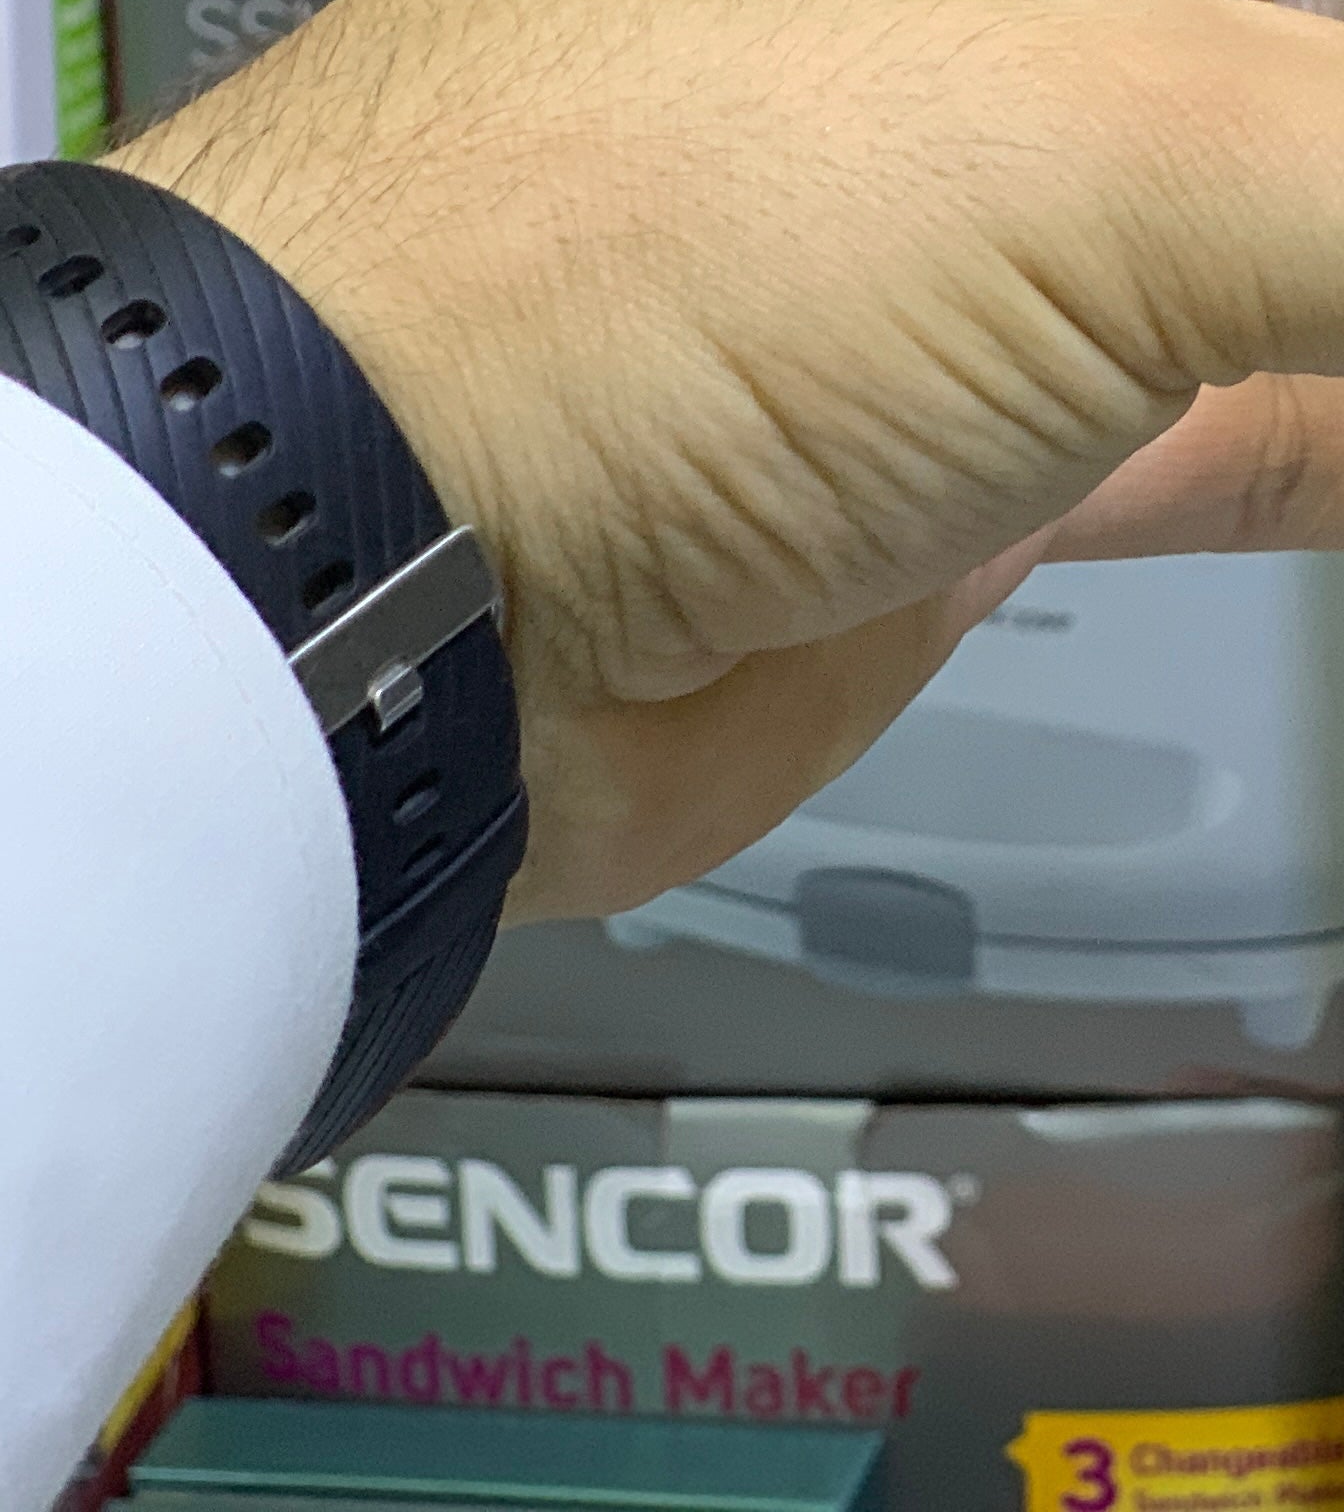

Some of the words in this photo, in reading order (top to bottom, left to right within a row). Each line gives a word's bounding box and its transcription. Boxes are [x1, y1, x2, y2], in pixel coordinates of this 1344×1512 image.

[240, 1152, 961, 1288] SENCOR
[253, 1312, 634, 1415] Sandwich
[660, 1342, 922, 1424] Maker
[1062, 1436, 1118, 1512] 3
